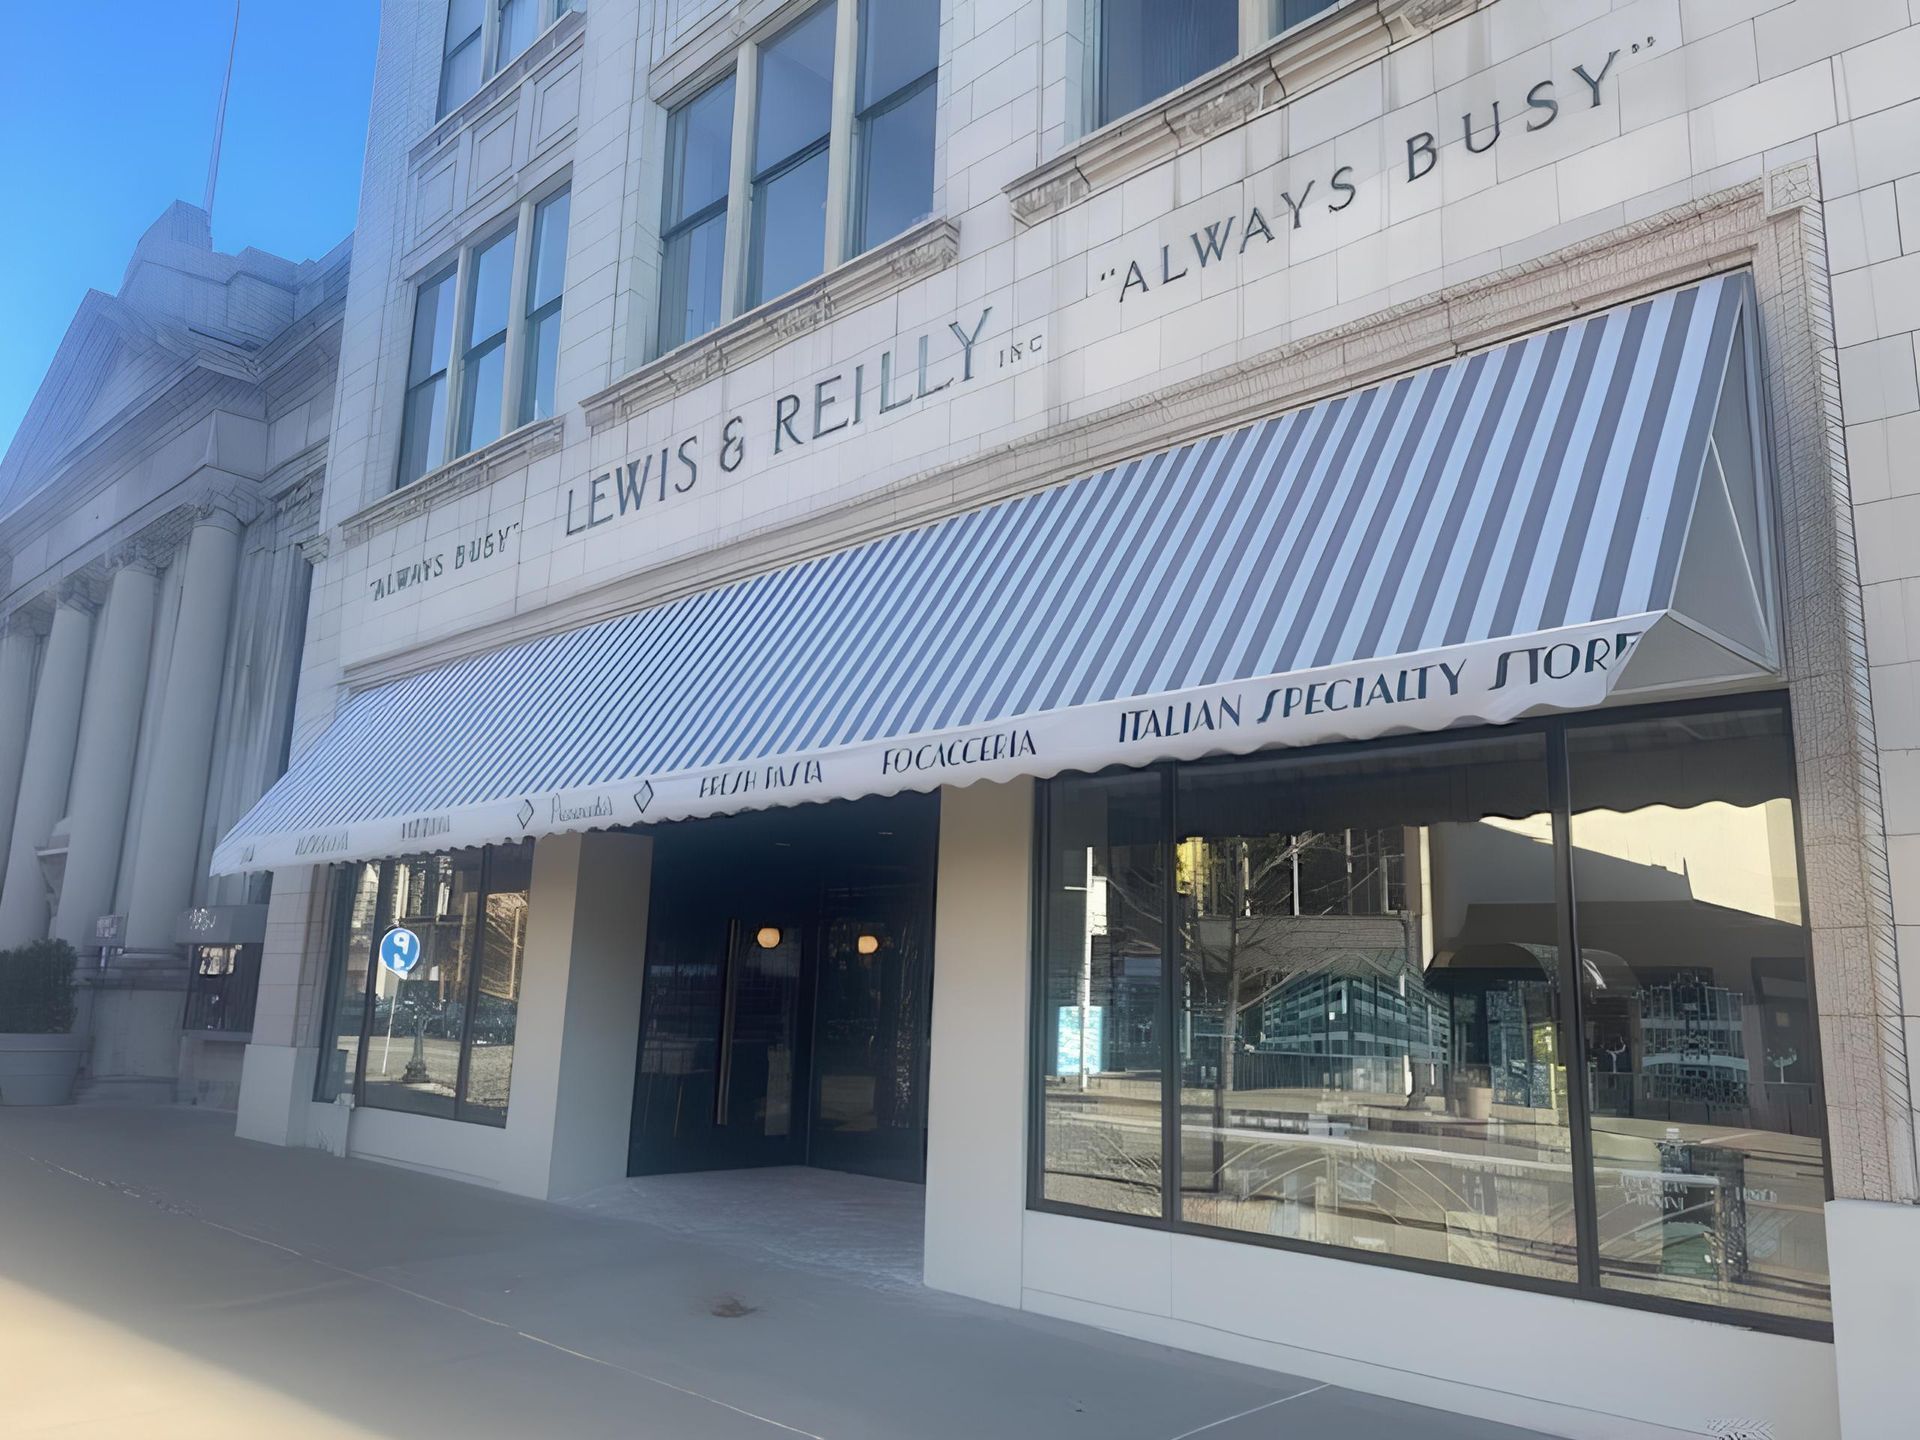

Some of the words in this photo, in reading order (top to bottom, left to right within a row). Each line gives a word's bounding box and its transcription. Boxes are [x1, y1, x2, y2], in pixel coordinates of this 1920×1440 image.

[566, 435, 699, 536] LEWIS
[720, 415, 745, 472] &
[774, 306, 993, 455] REILLY
[1118, 693, 1242, 743] ITALIAN
[1256, 658, 1467, 725] SPECIALTY
[882, 729, 1037, 776] FOCACCERIA
